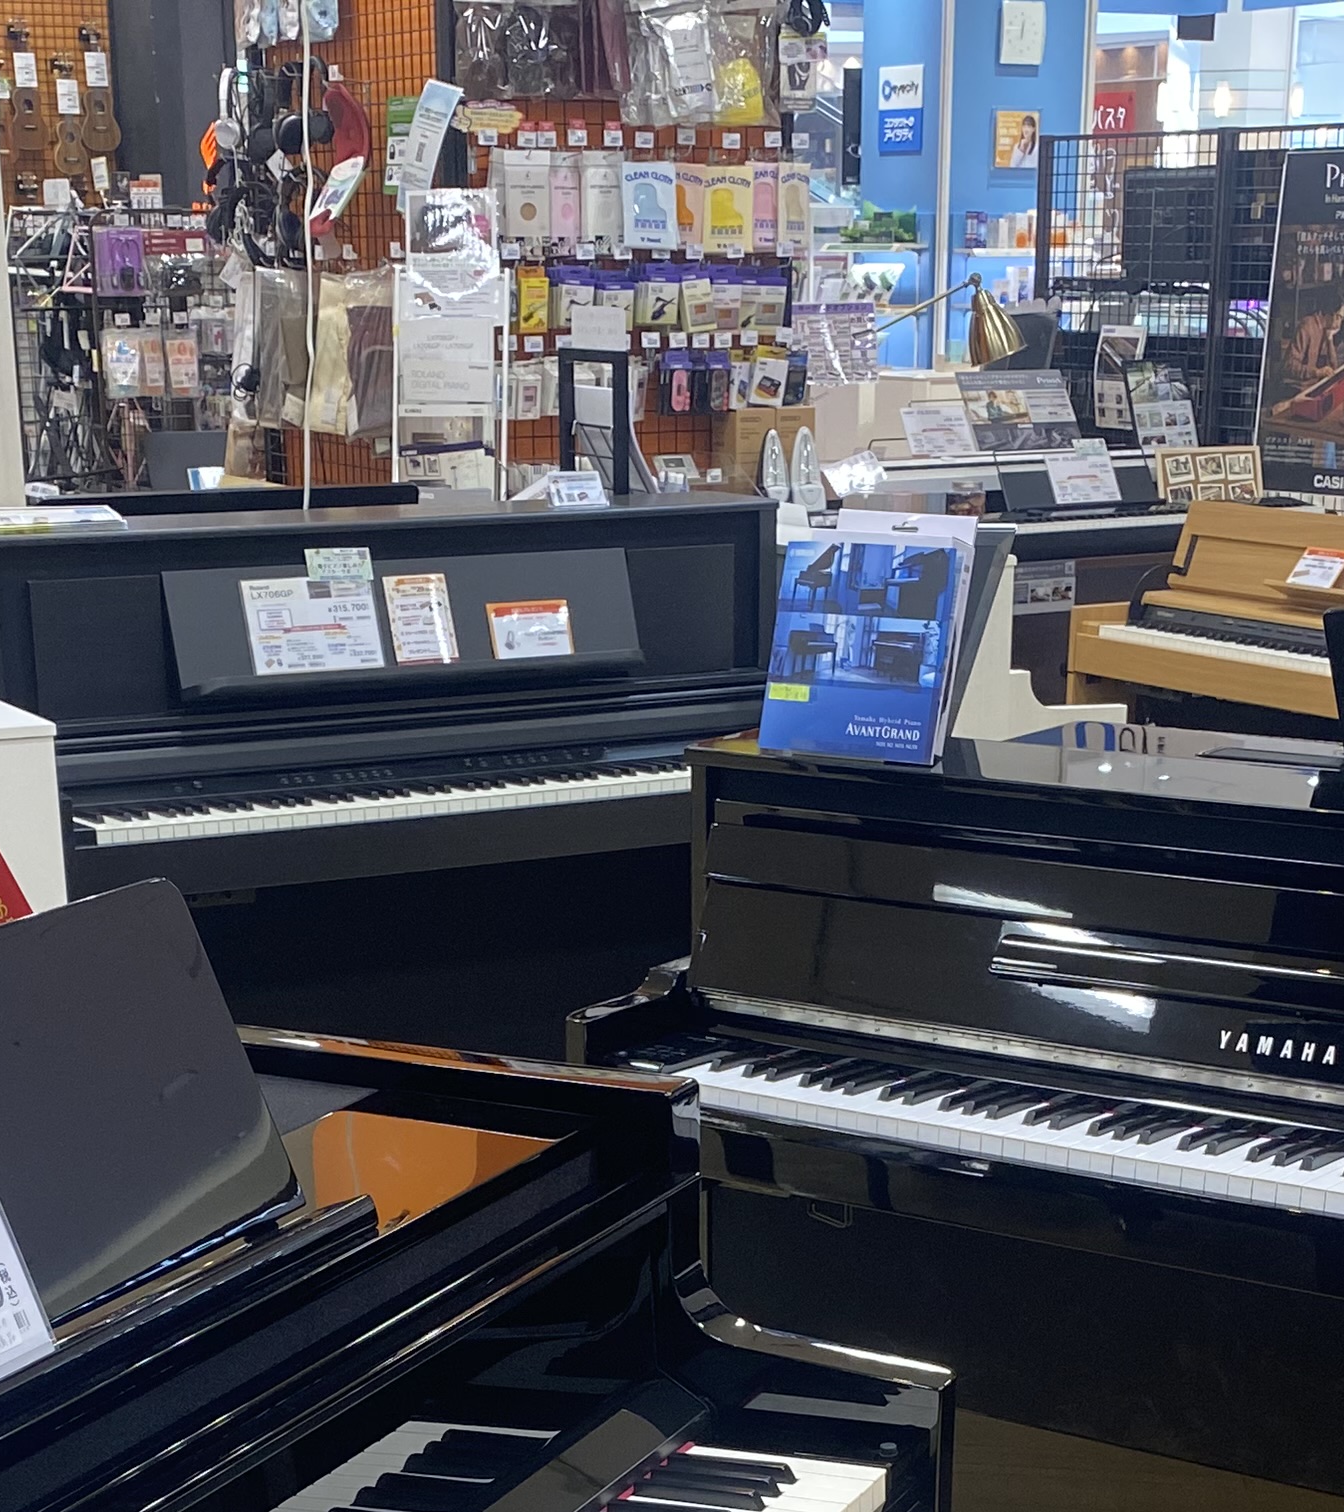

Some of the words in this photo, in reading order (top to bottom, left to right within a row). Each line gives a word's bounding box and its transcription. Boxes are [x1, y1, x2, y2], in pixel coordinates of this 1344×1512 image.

[1092, 105, 1127, 130] パスタ
[624, 171, 650, 183] CLEAN
[651, 171, 674, 185] CLOTH
[1219, 1030, 1339, 1066] YAMAHA
